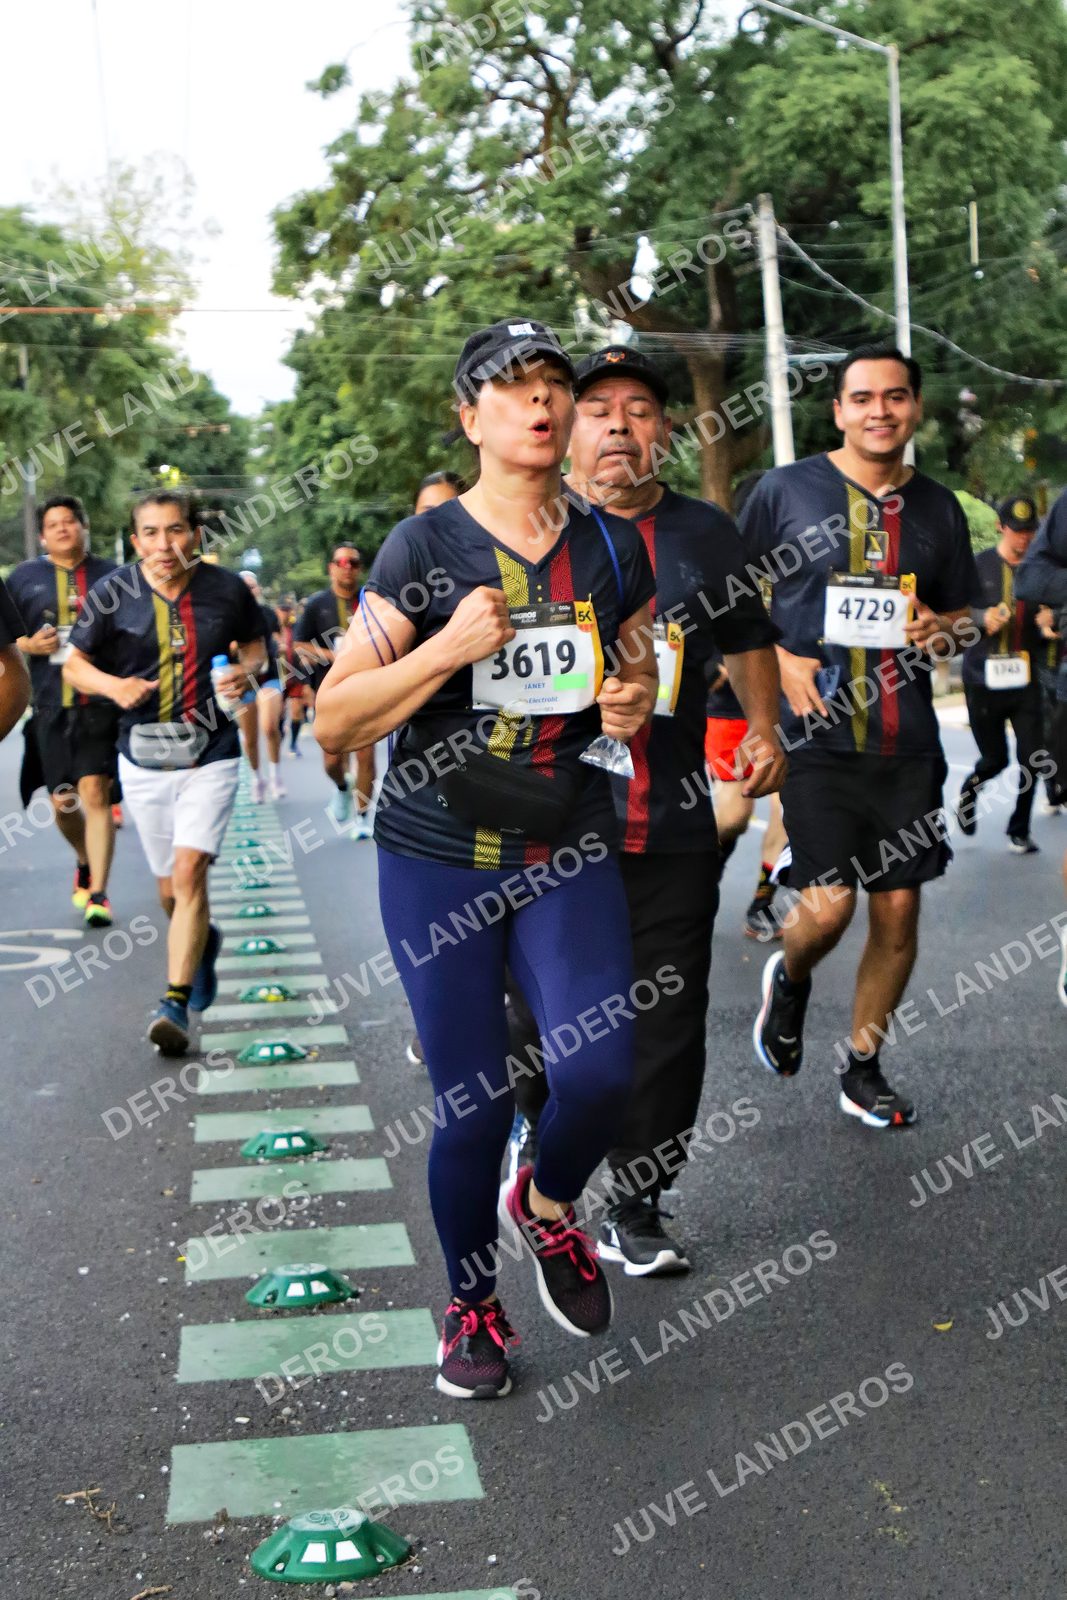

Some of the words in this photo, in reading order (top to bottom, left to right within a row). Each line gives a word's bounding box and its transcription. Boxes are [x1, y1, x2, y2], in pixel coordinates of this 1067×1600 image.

[577, 610, 593, 622] 5K
[838, 597, 896, 622] 4729
[491, 639, 577, 681] 3619
